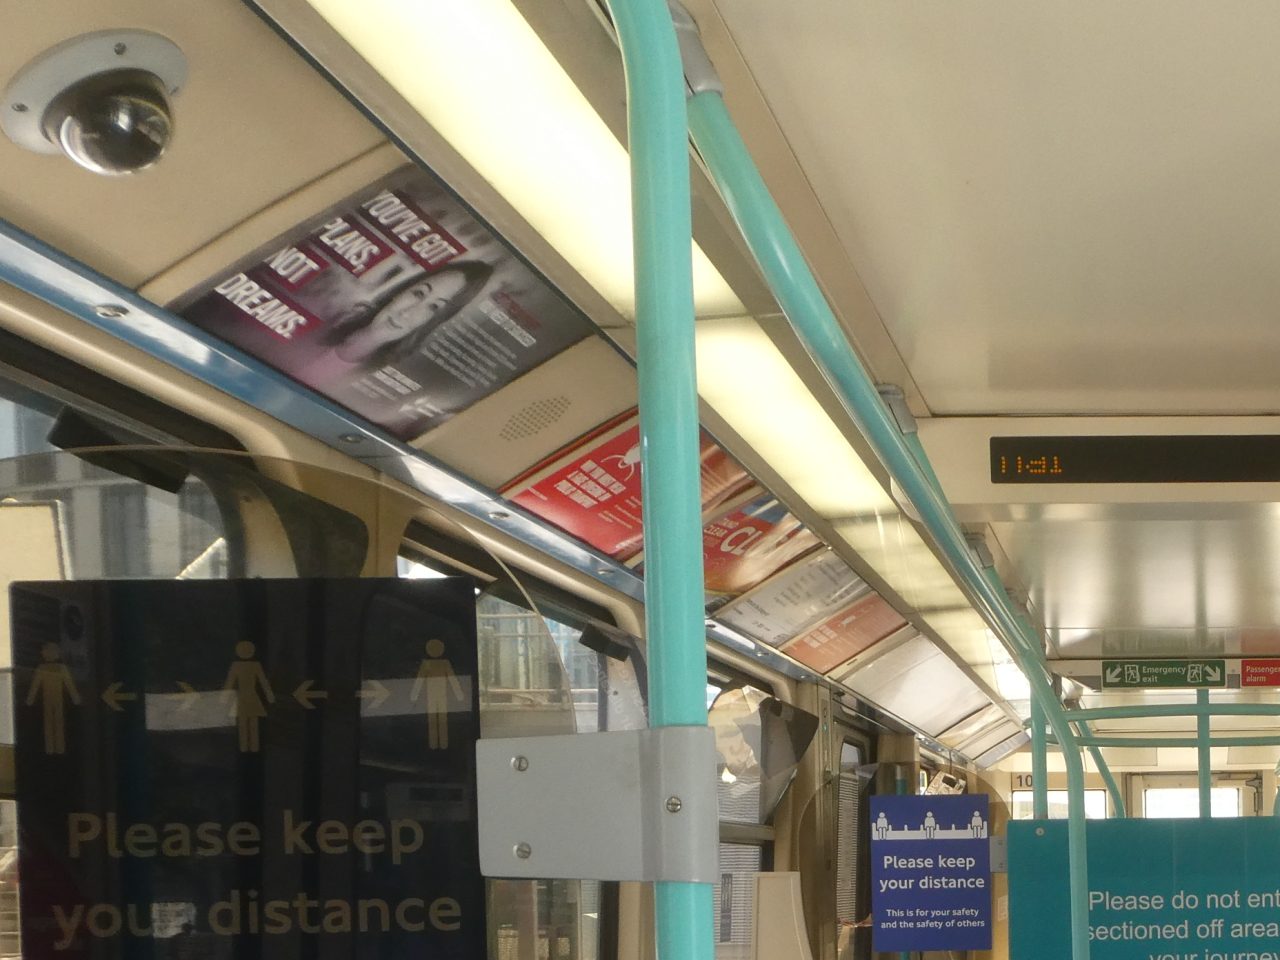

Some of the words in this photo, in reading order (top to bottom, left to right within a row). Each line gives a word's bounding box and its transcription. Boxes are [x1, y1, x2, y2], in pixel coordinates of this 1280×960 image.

[361, 190, 431, 243] YOU'VE
[411, 233, 458, 265] GOT
[318, 218, 380, 276] PLANS,
[264, 246, 320, 284] NOT
[214, 273, 307, 340] DREAMS.
[1142, 666, 1186, 675] Emergency
[1246, 666, 1280, 674] Passenger
[66, 813, 260, 858] Please
[283, 810, 424, 865] keep
[884, 856, 933, 868] Please
[939, 855, 975, 869] keep
[880, 880, 914, 892] your
[919, 876, 984, 888] distance
[1089, 890, 1164, 911] Please
[1172, 891, 1198, 909] do
[1207, 891, 1240, 908] not
[51, 903, 158, 950] you
[208, 890, 461, 936] distance
[953, 908, 978, 916] safety
[917, 920, 943, 928] safety
[1088, 921, 1189, 942] sectioned
[1197, 919, 1224, 938] off
[1231, 923, 1278, 937] area
